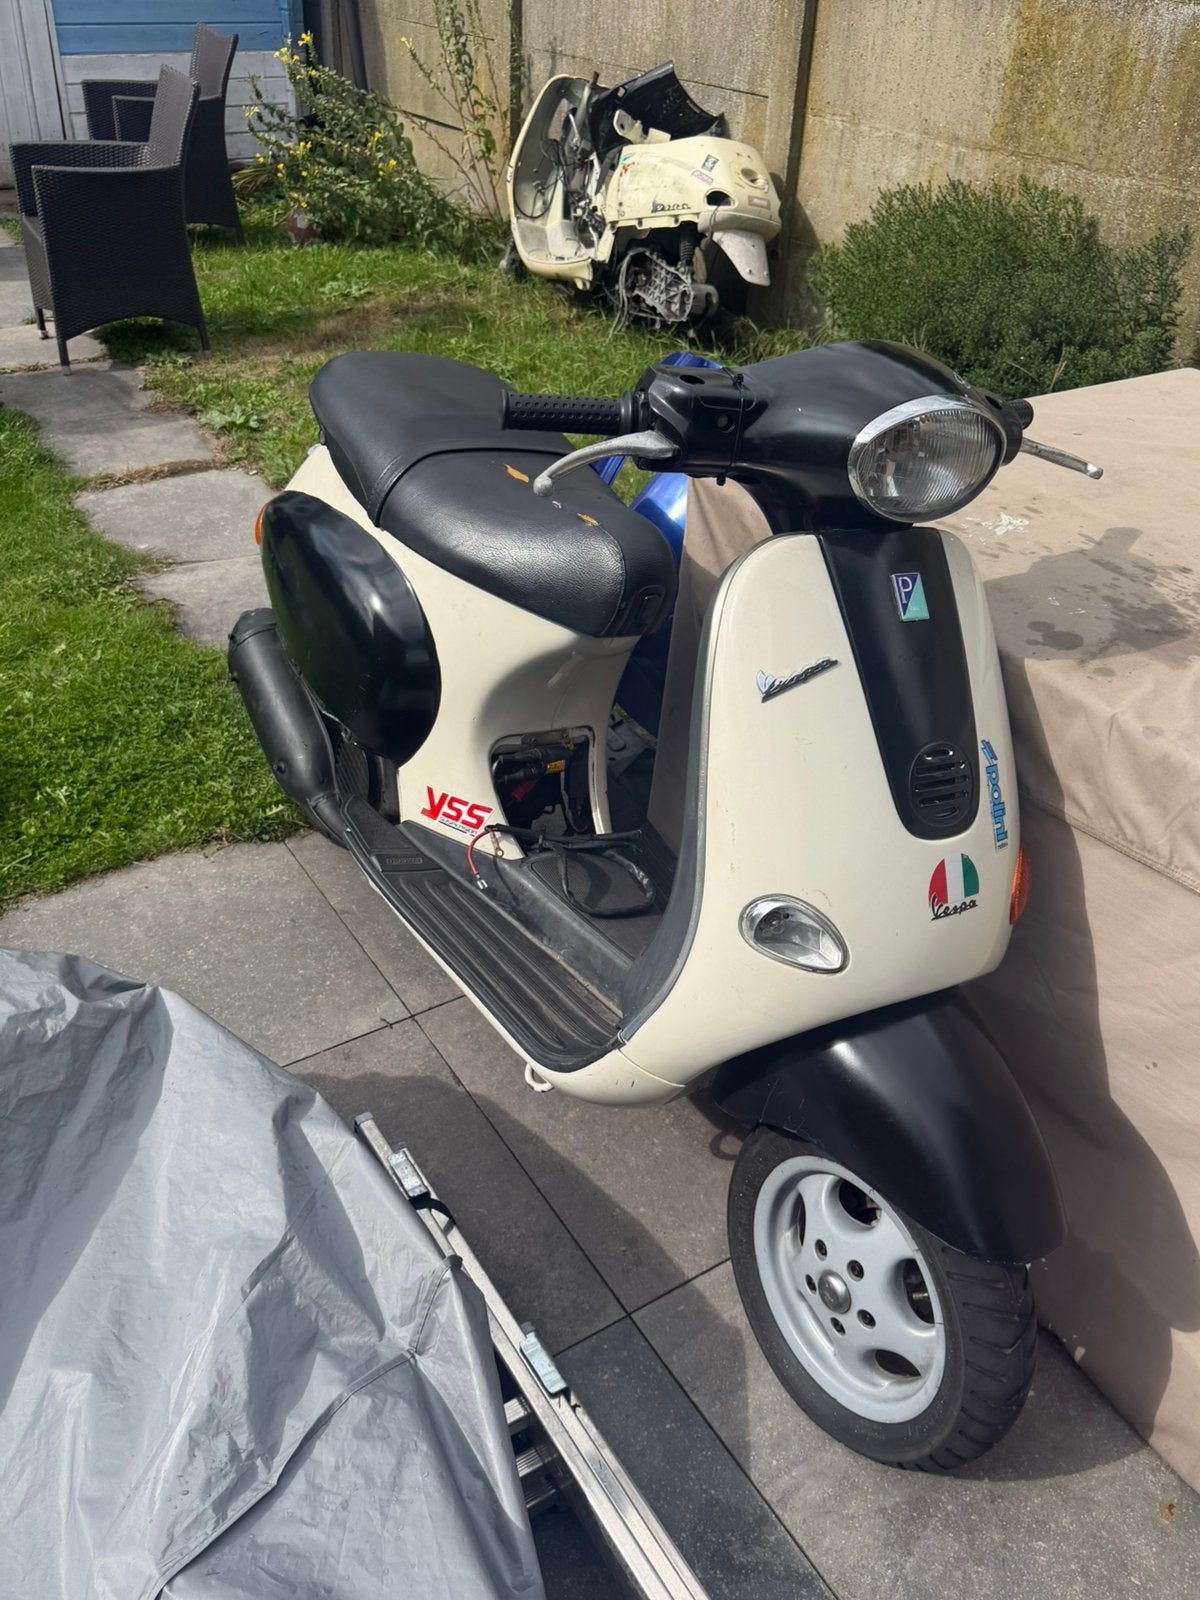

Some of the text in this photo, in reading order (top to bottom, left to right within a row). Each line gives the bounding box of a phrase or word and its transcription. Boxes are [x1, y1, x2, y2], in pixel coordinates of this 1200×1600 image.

[897, 576, 913, 604] P
[420, 785, 494, 831] YSS
[931, 893, 979, 921] Vespa
